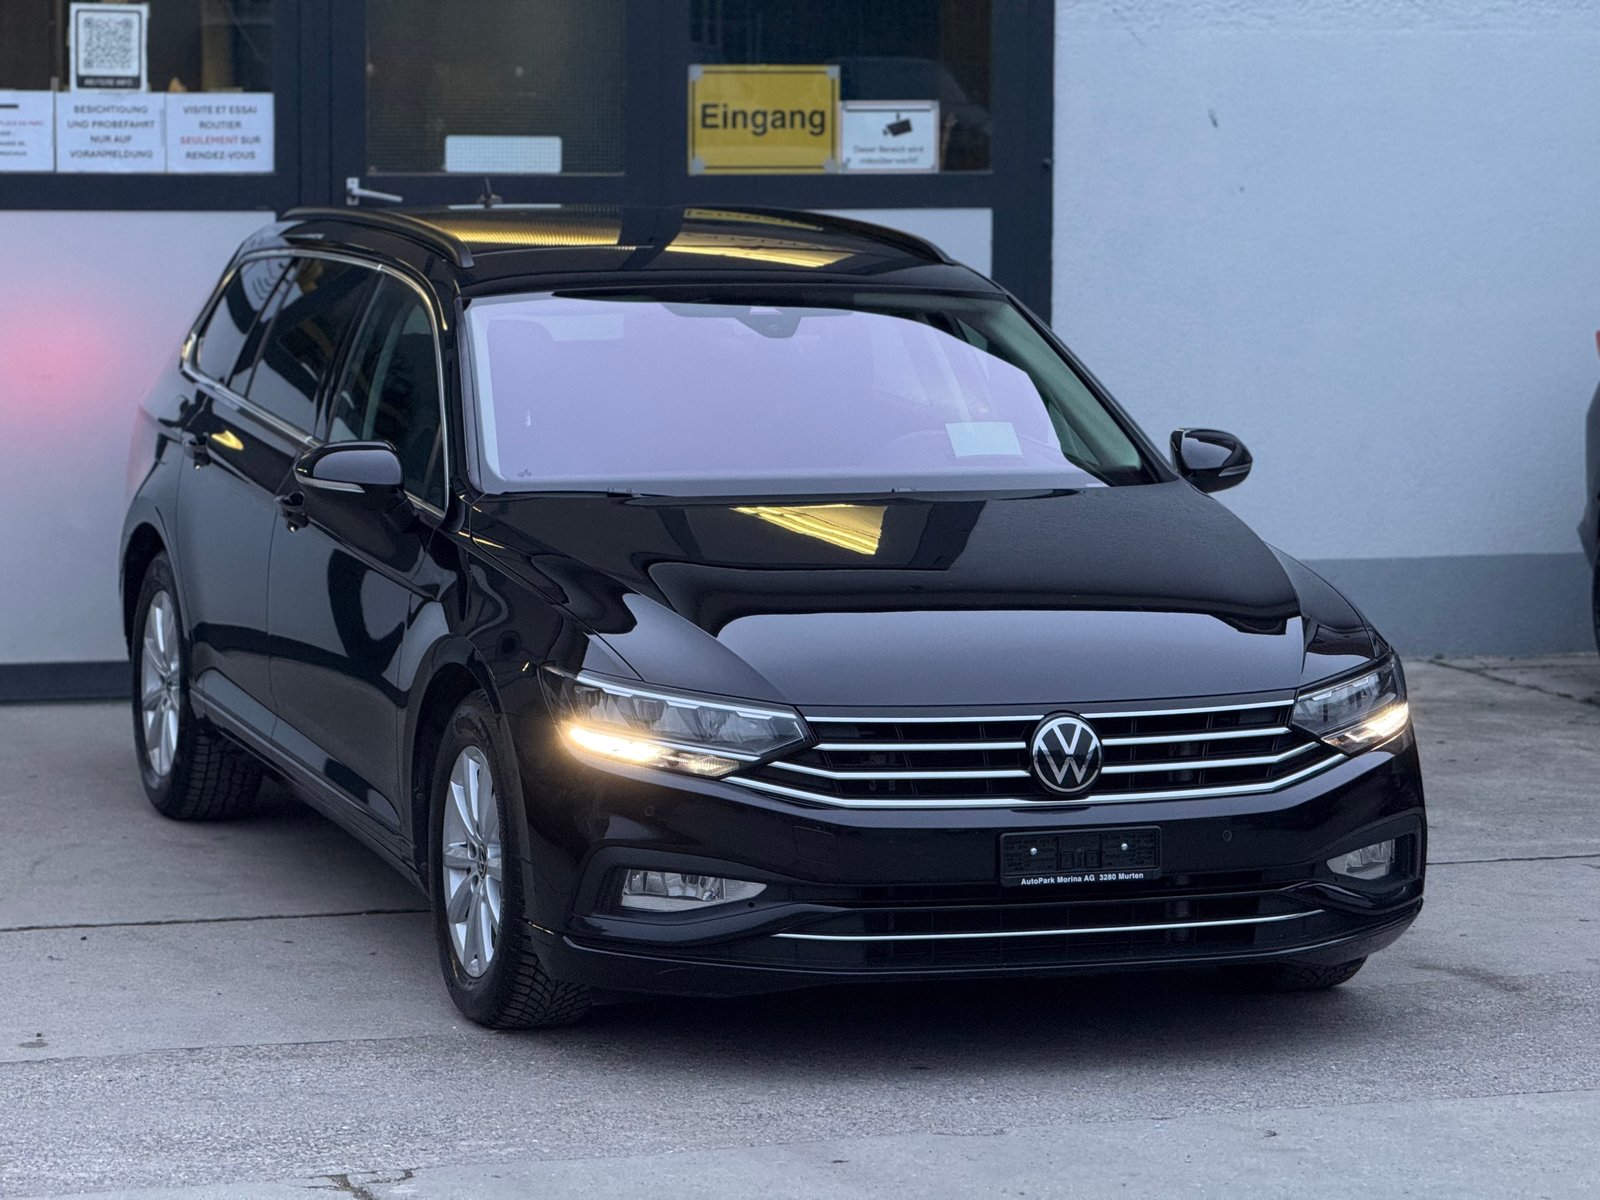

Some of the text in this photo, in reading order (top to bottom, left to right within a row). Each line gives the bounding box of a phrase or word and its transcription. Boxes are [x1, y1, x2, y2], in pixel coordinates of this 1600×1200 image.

[73, 105, 148, 114] BESICHTIGUNG
[183, 105, 258, 114] VISITE ET ESSAI
[67, 120, 155, 128] UND PROBEFAHRT
[701, 103, 825, 136] Eingang
[199, 120, 242, 129] ROUTIER
[90, 135, 132, 143] NUR AUF
[180, 135, 261, 145] SEULEMENT SUR
[69, 150, 153, 159] VORANMELDUNG
[185, 150, 256, 160] RENDEZ-VOUS
[1033, 717, 1101, 791] VW
[1021, 877, 1055, 885] AutoPark
[1099, 873, 1116, 881] 3280
[1118, 872, 1144, 880] Murten
